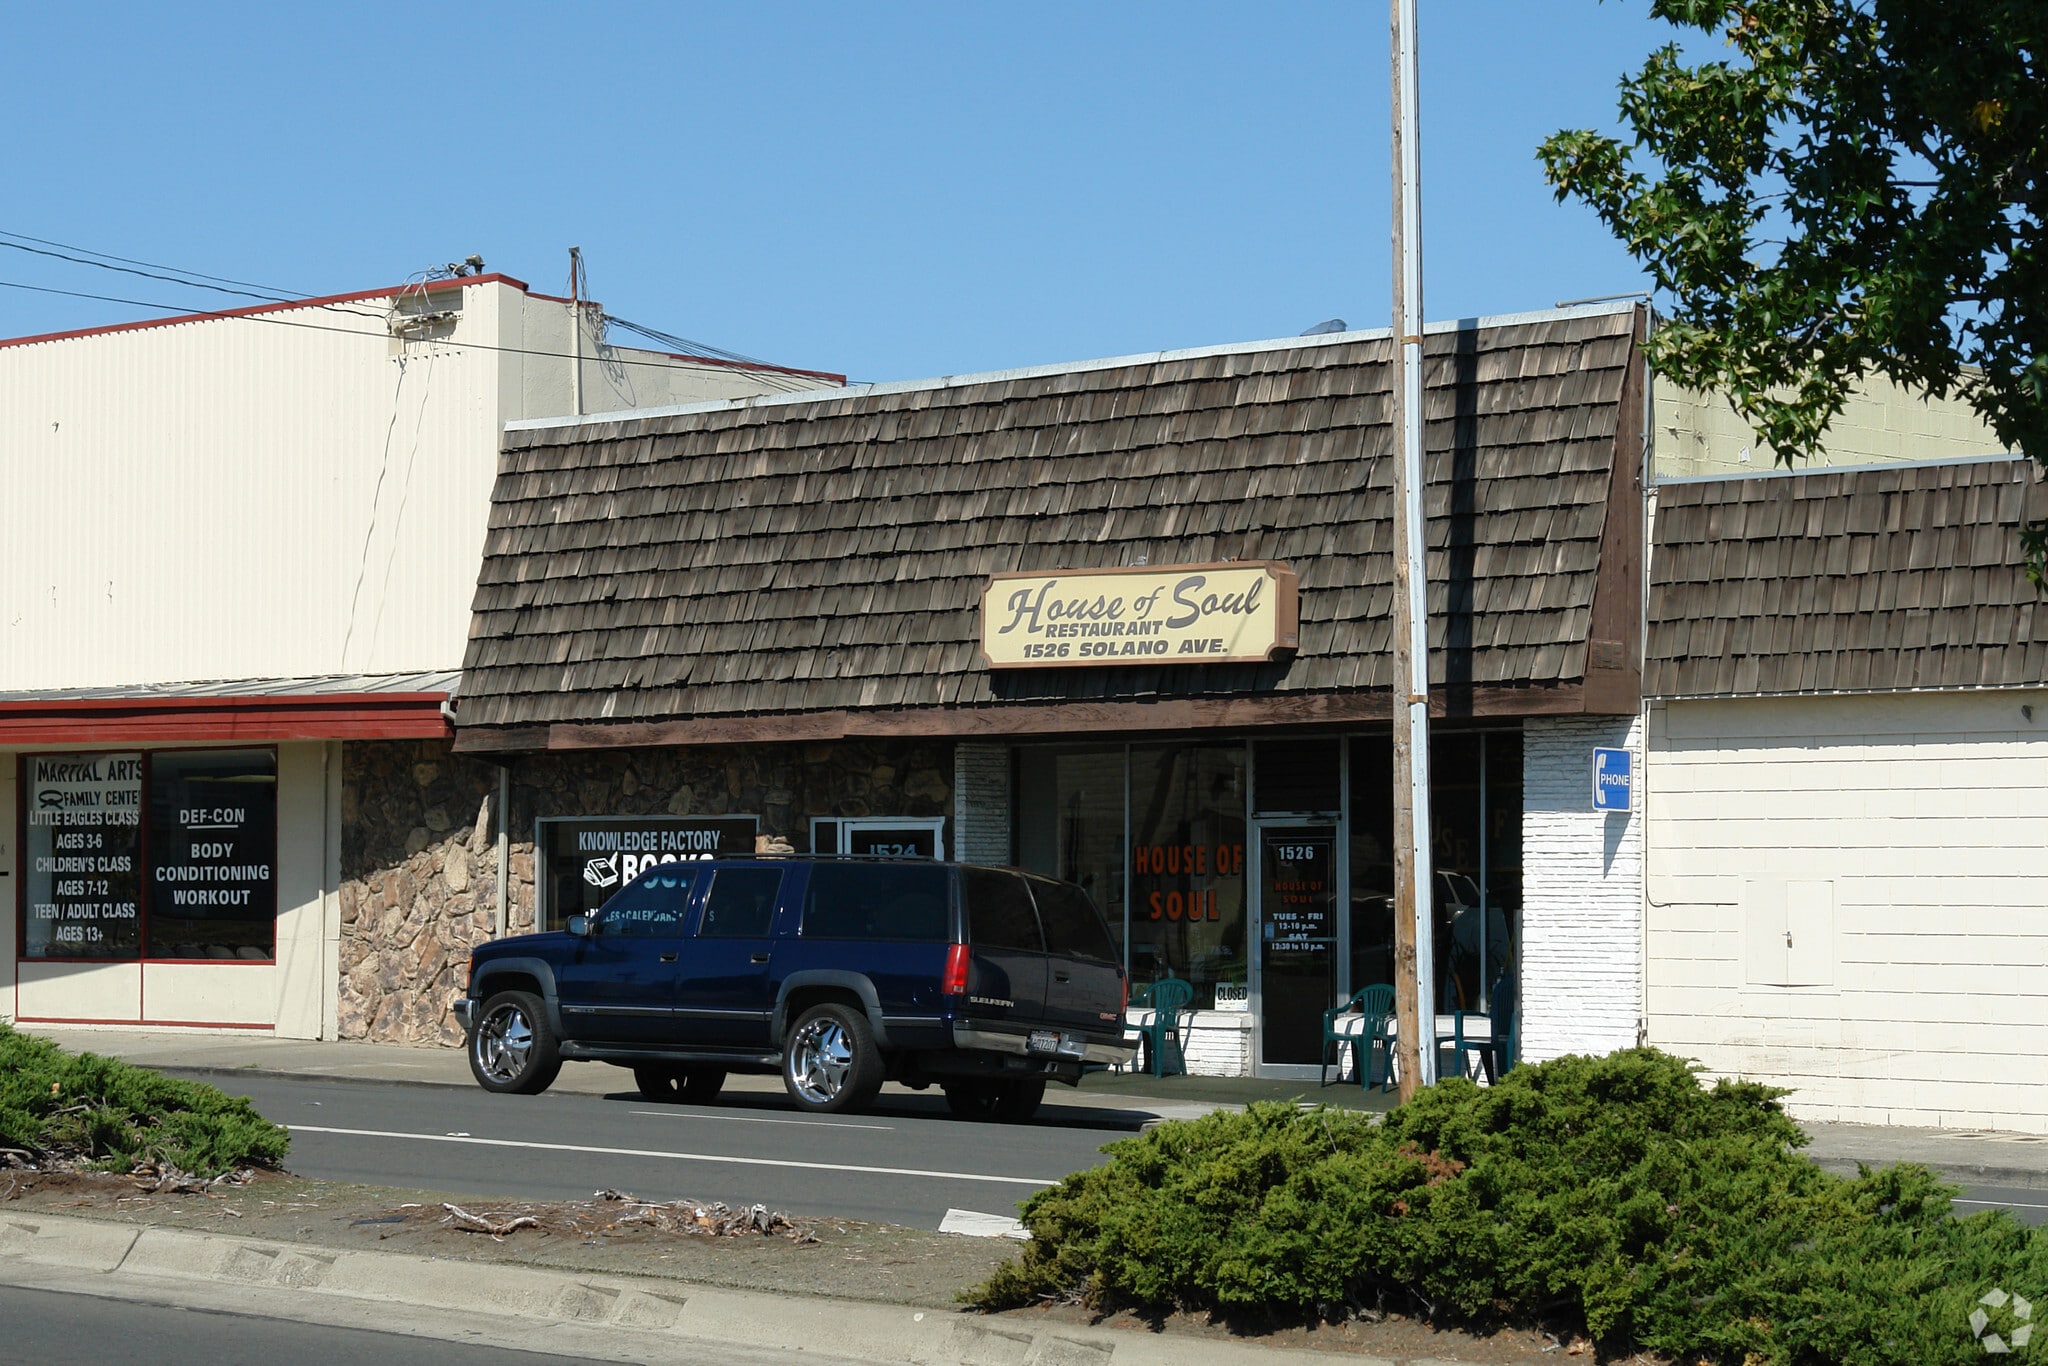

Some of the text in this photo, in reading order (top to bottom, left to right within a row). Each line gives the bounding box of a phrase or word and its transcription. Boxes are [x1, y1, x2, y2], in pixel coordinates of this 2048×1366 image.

[998, 575, 1263, 634] House of Soul
[1045, 620, 1163, 638] RESTAURANT
[1023, 638, 1229, 658] 1526 SOLANO AVE.
[37, 760, 142, 782] MARTIAL ARTS
[1600, 773, 1630, 786] PHONE
[63, 790, 141, 806] FAMILY CENTE
[29, 810, 139, 826] LITTLE EAGLES CLASS
[179, 808, 245, 824] DEF-CON
[56, 833, 103, 849] AGES 3-6
[578, 830, 721, 851] KNOWLEDGE FACTORY
[191, 843, 234, 858] BODY
[1279, 846, 1314, 860] 1526
[35, 856, 131, 873] CHILDREN'S CLASS
[1135, 844, 1243, 876] HOUSE OF
[155, 865, 270, 881] CONDITIONING
[56, 880, 108, 896] AGES 7-12
[1274, 881, 1306, 891] HOUSE
[173, 890, 251, 905] WORKOUT
[1149, 890, 1220, 921] SOUL
[102, 903, 136, 919] CLASS
[1272, 912, 1297, 920] TUES
[1307, 912, 1323, 920] FRI
[56, 926, 103, 942] AGES 13+
[1288, 933, 1308, 941] SAT
[1217, 986, 1247, 1001] CLOSED
